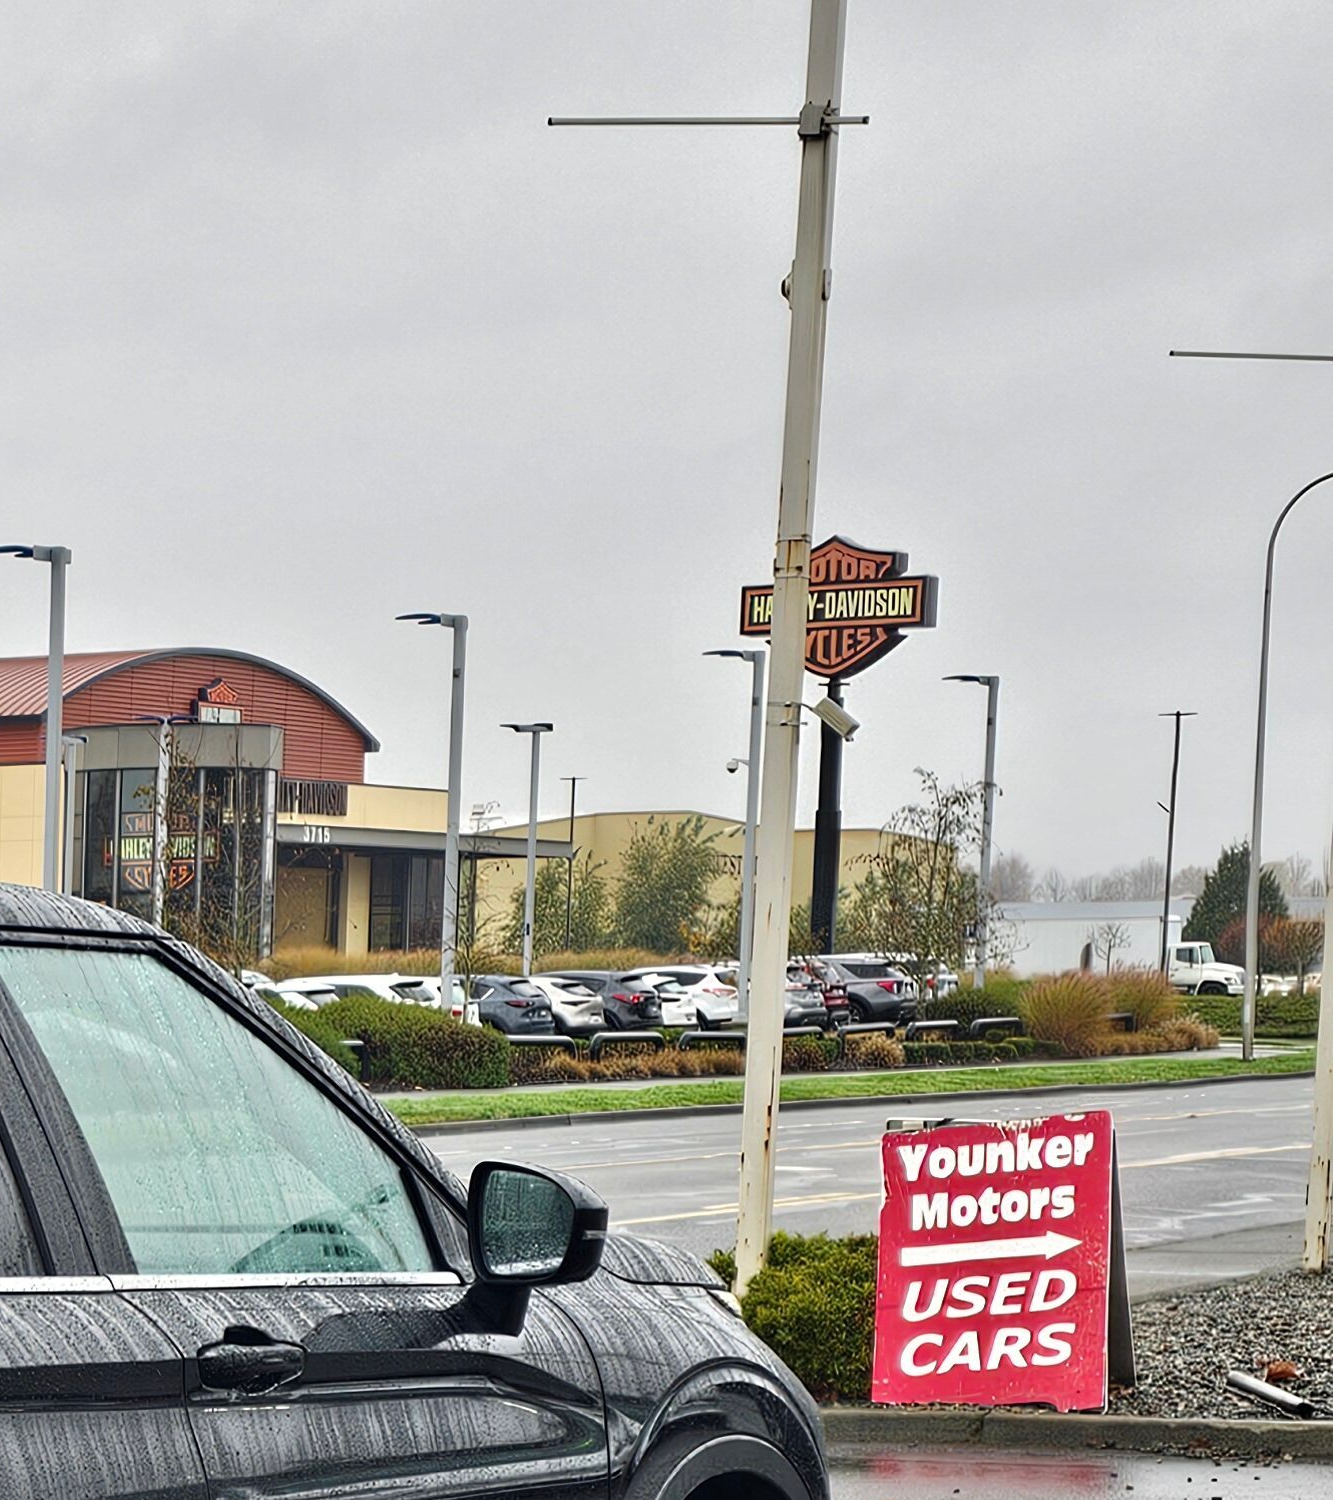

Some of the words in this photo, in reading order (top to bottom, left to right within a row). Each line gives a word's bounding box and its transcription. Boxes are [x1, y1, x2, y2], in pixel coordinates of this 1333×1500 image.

[810, 549, 877, 583] OTOR
[753, 587, 914, 623] HAY-DAVIDSON
[805, 628, 872, 666] YCLES
[897, 1131, 1094, 1182] Younker
[911, 1184, 1075, 1231] Motors
[901, 1269, 1077, 1323] USED
[899, 1322, 1077, 1377] CARS
